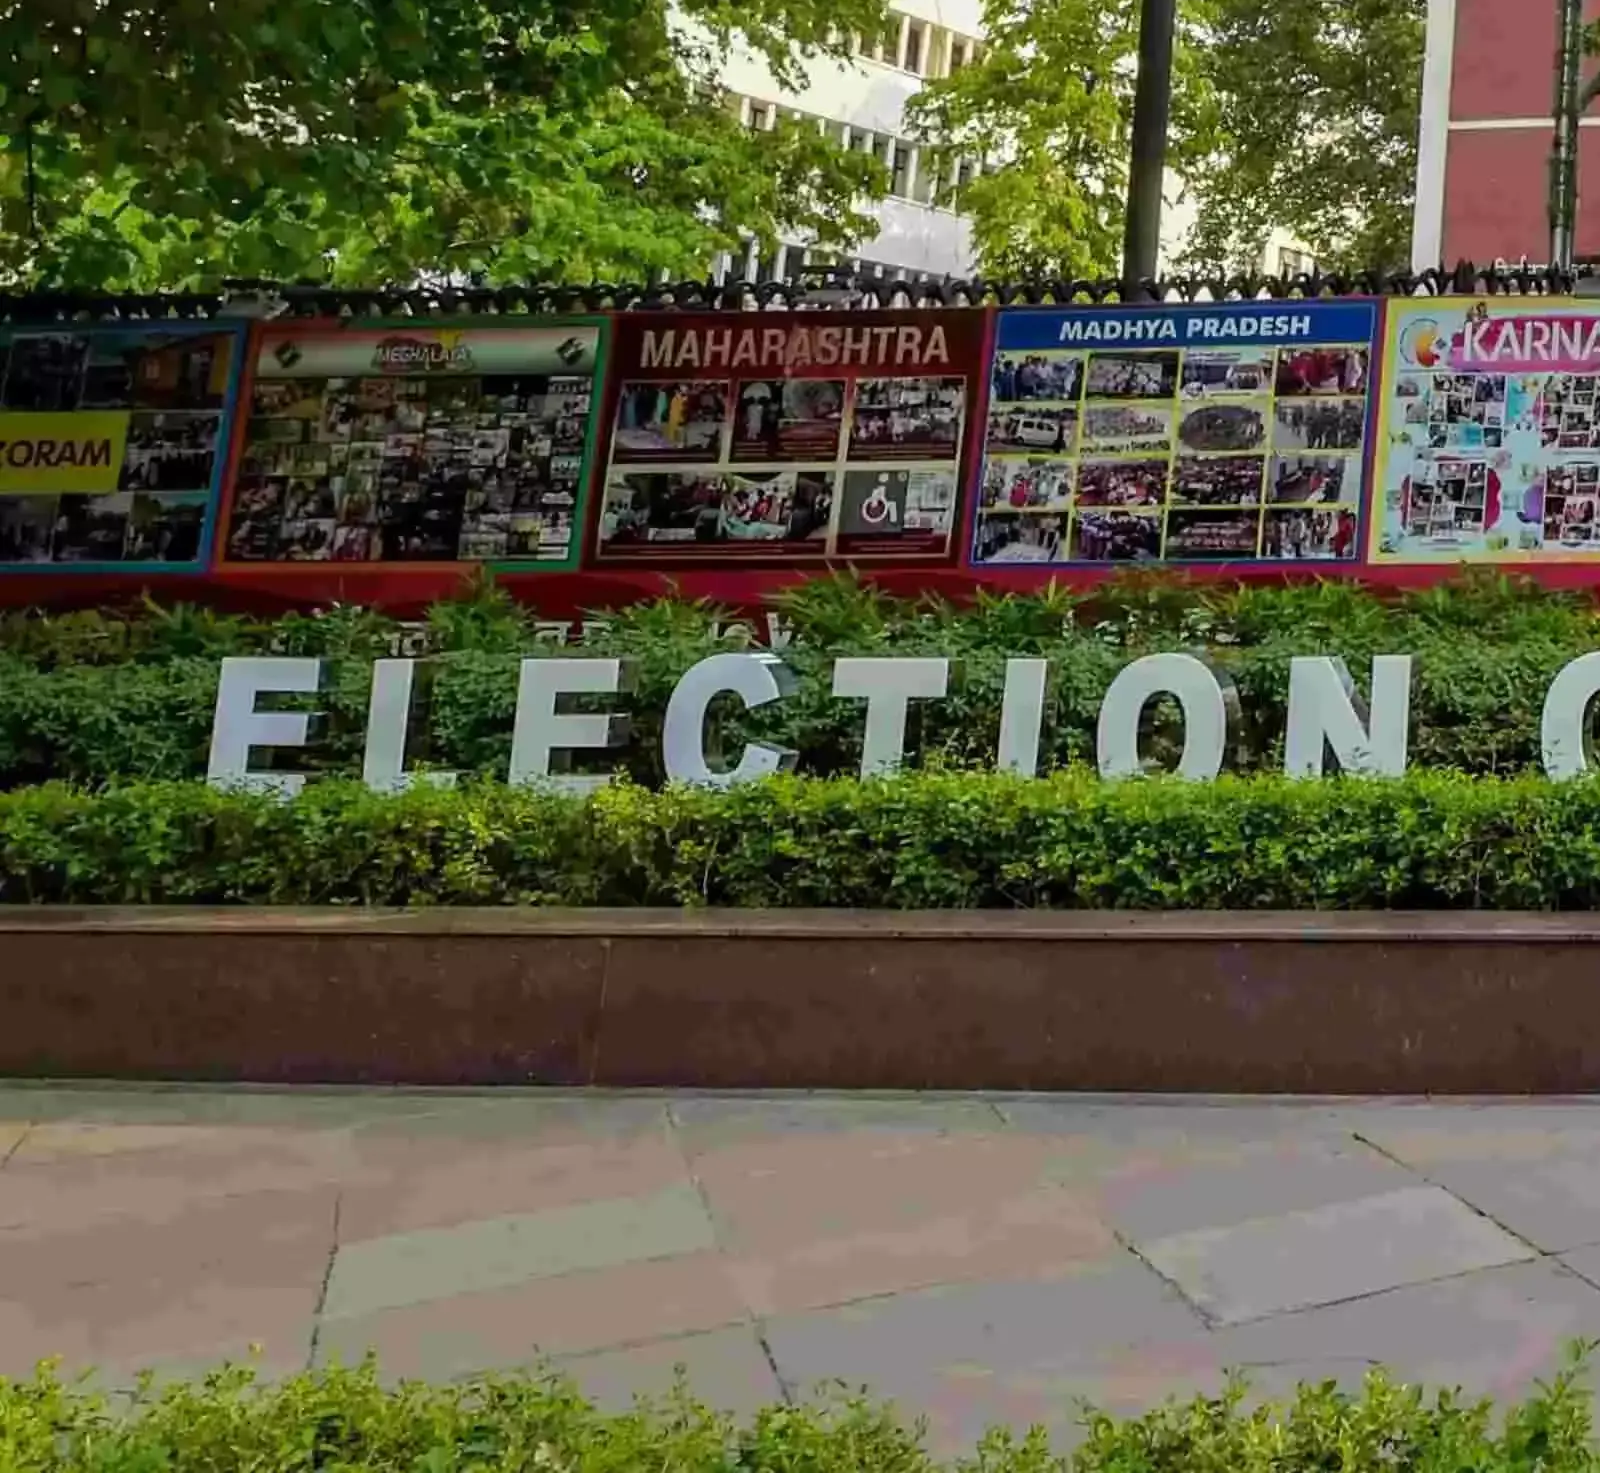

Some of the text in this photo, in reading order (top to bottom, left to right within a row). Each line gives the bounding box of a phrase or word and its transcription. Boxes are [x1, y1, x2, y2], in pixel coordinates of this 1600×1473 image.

[640, 325, 950, 369] MAHARASHTRA
[1058, 315, 1310, 341] MADHYA PRADESH
[207, 652, 1412, 800] ELECTION
